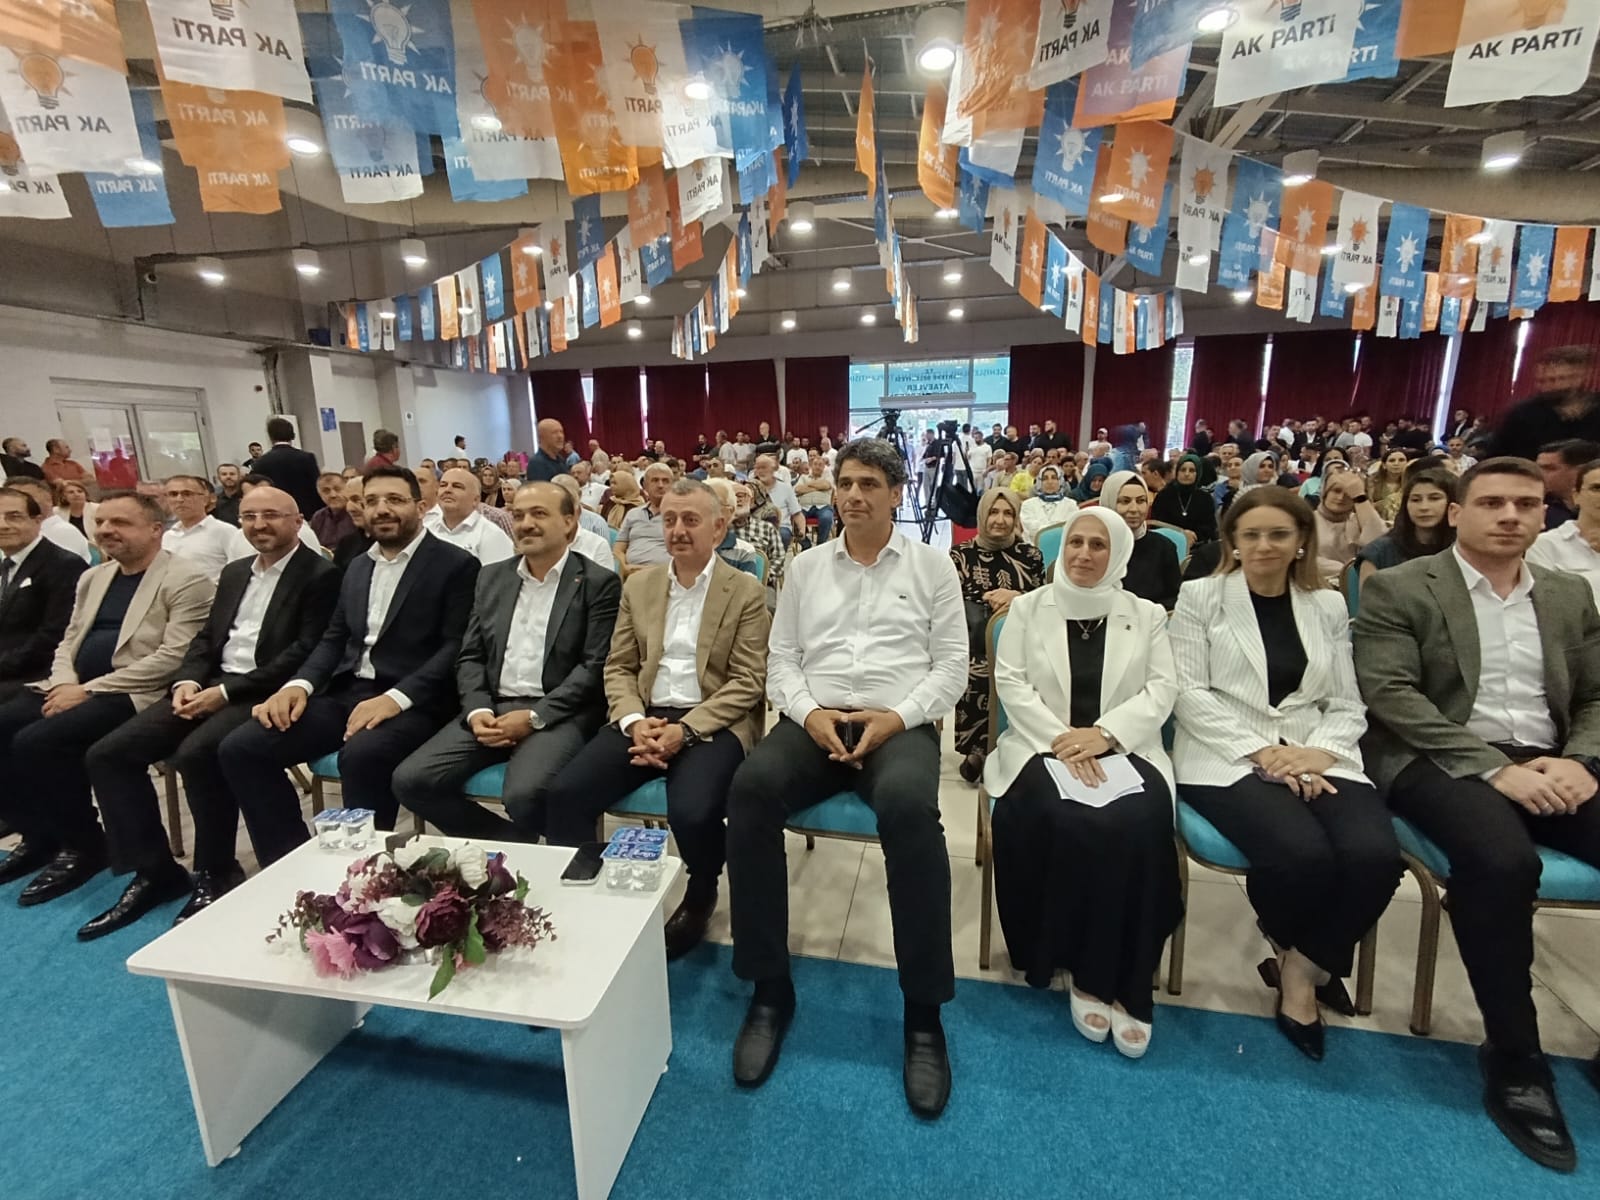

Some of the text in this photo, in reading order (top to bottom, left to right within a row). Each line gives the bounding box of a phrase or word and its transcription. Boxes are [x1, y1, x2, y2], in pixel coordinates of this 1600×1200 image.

[1106, 47, 1131, 65] AK
[1231, 34, 1264, 59] AK
[1468, 40, 1504, 60] AK
[1091, 82, 1113, 97] AK
